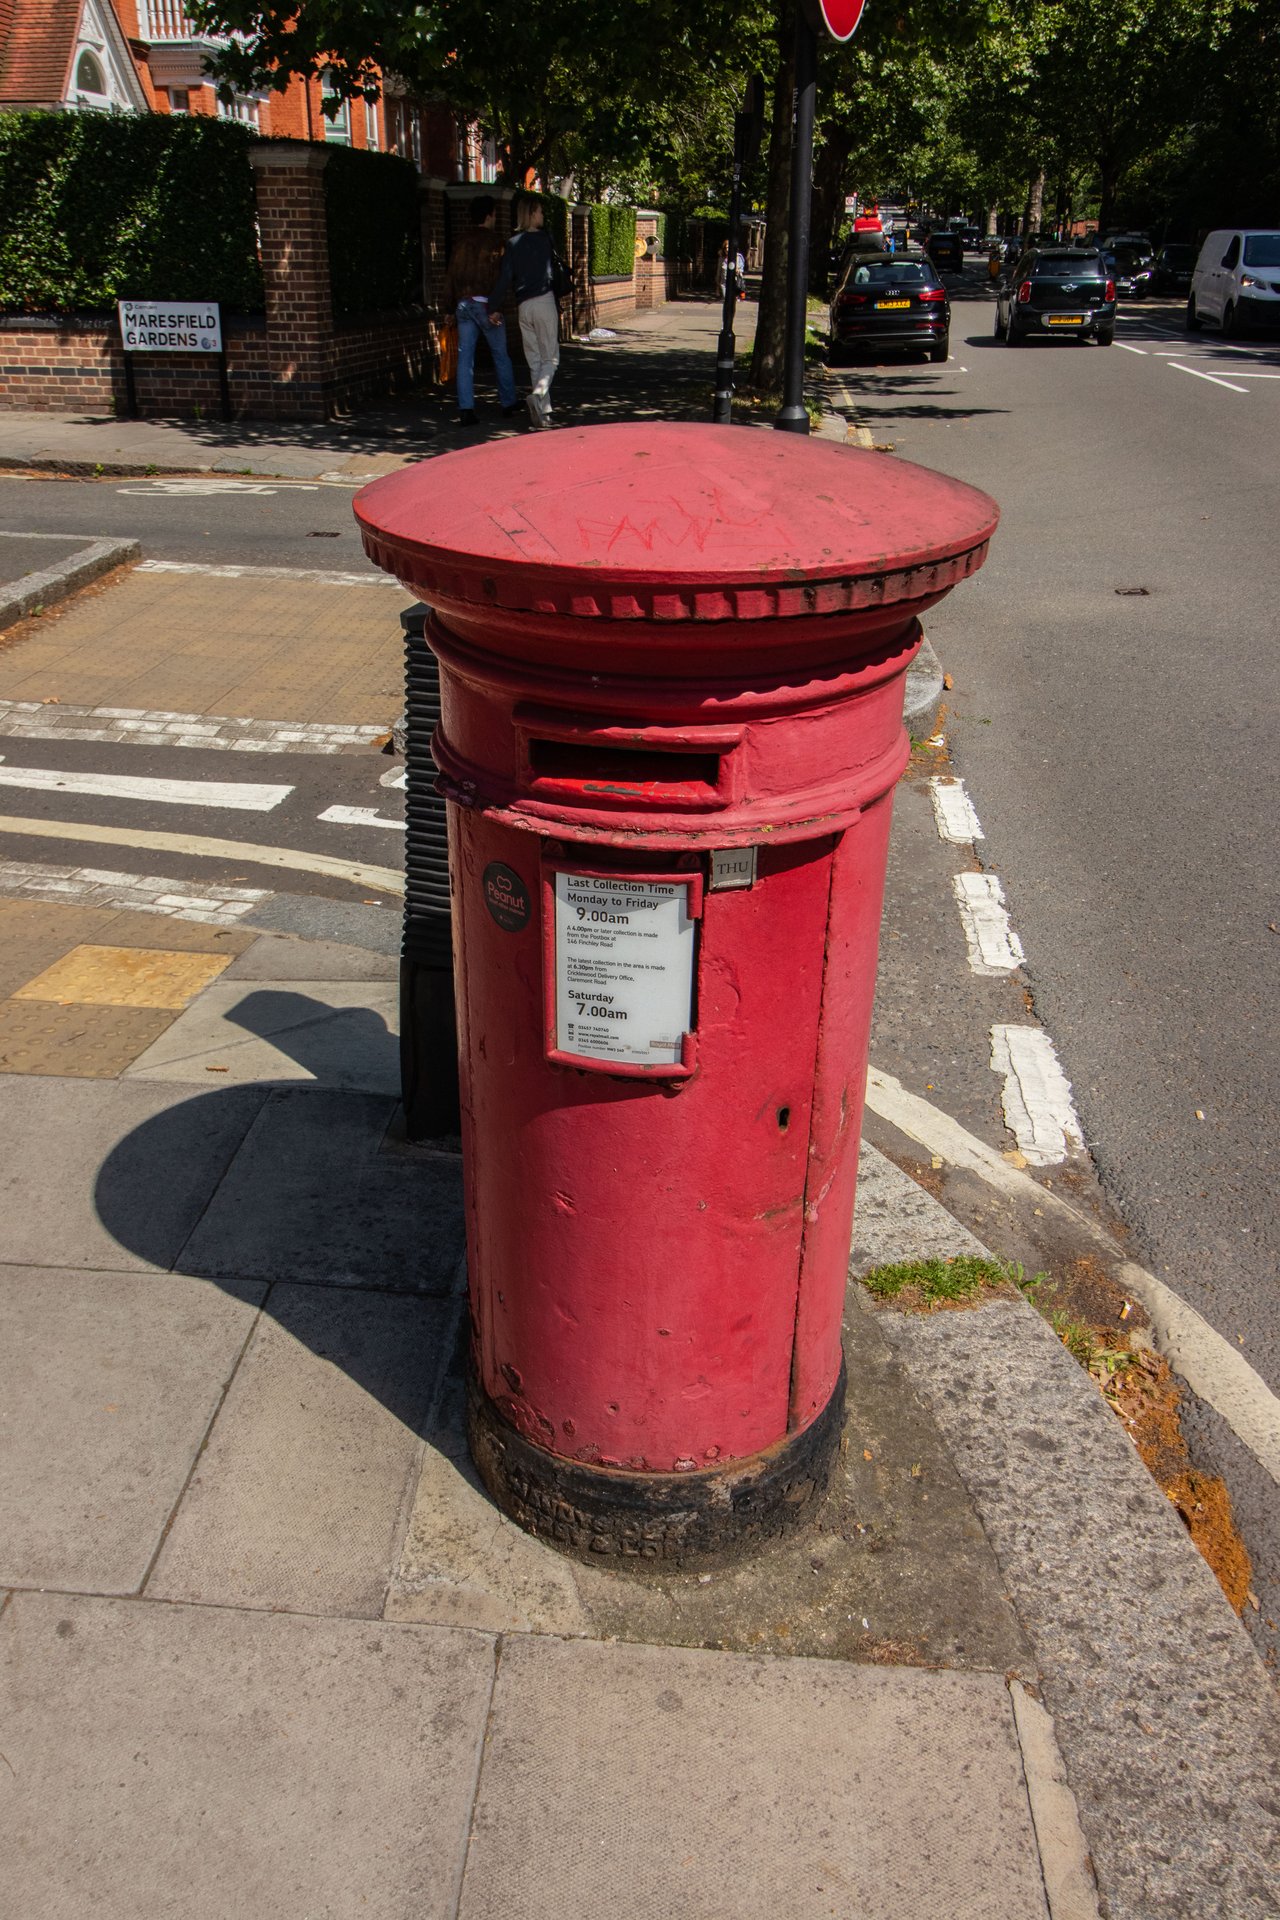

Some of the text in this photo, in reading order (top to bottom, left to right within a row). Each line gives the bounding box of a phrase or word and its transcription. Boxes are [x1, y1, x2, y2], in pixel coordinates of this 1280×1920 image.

[125, 313, 216, 329] MARESFIELD
[126, 332, 198, 347] GARDENS
[717, 861, 749, 875] THU
[567, 877, 675, 895] Last Collection Time
[488, 881, 525, 910] Peanut
[567, 893, 659, 910] Monday to Friday
[576, 907, 629, 925] 9.00am
[613, 929, 637, 937] collection
[579, 939, 599, 947] Finchley
[593, 959, 616, 967] collection
[567, 970, 596, 978] Cricklewood
[619, 974, 635, 982] Office,
[568, 990, 614, 1004] Saturday
[576, 1002, 628, 1020] 7.00am
[578, 1031, 619, 1040] www.royalmail.com
